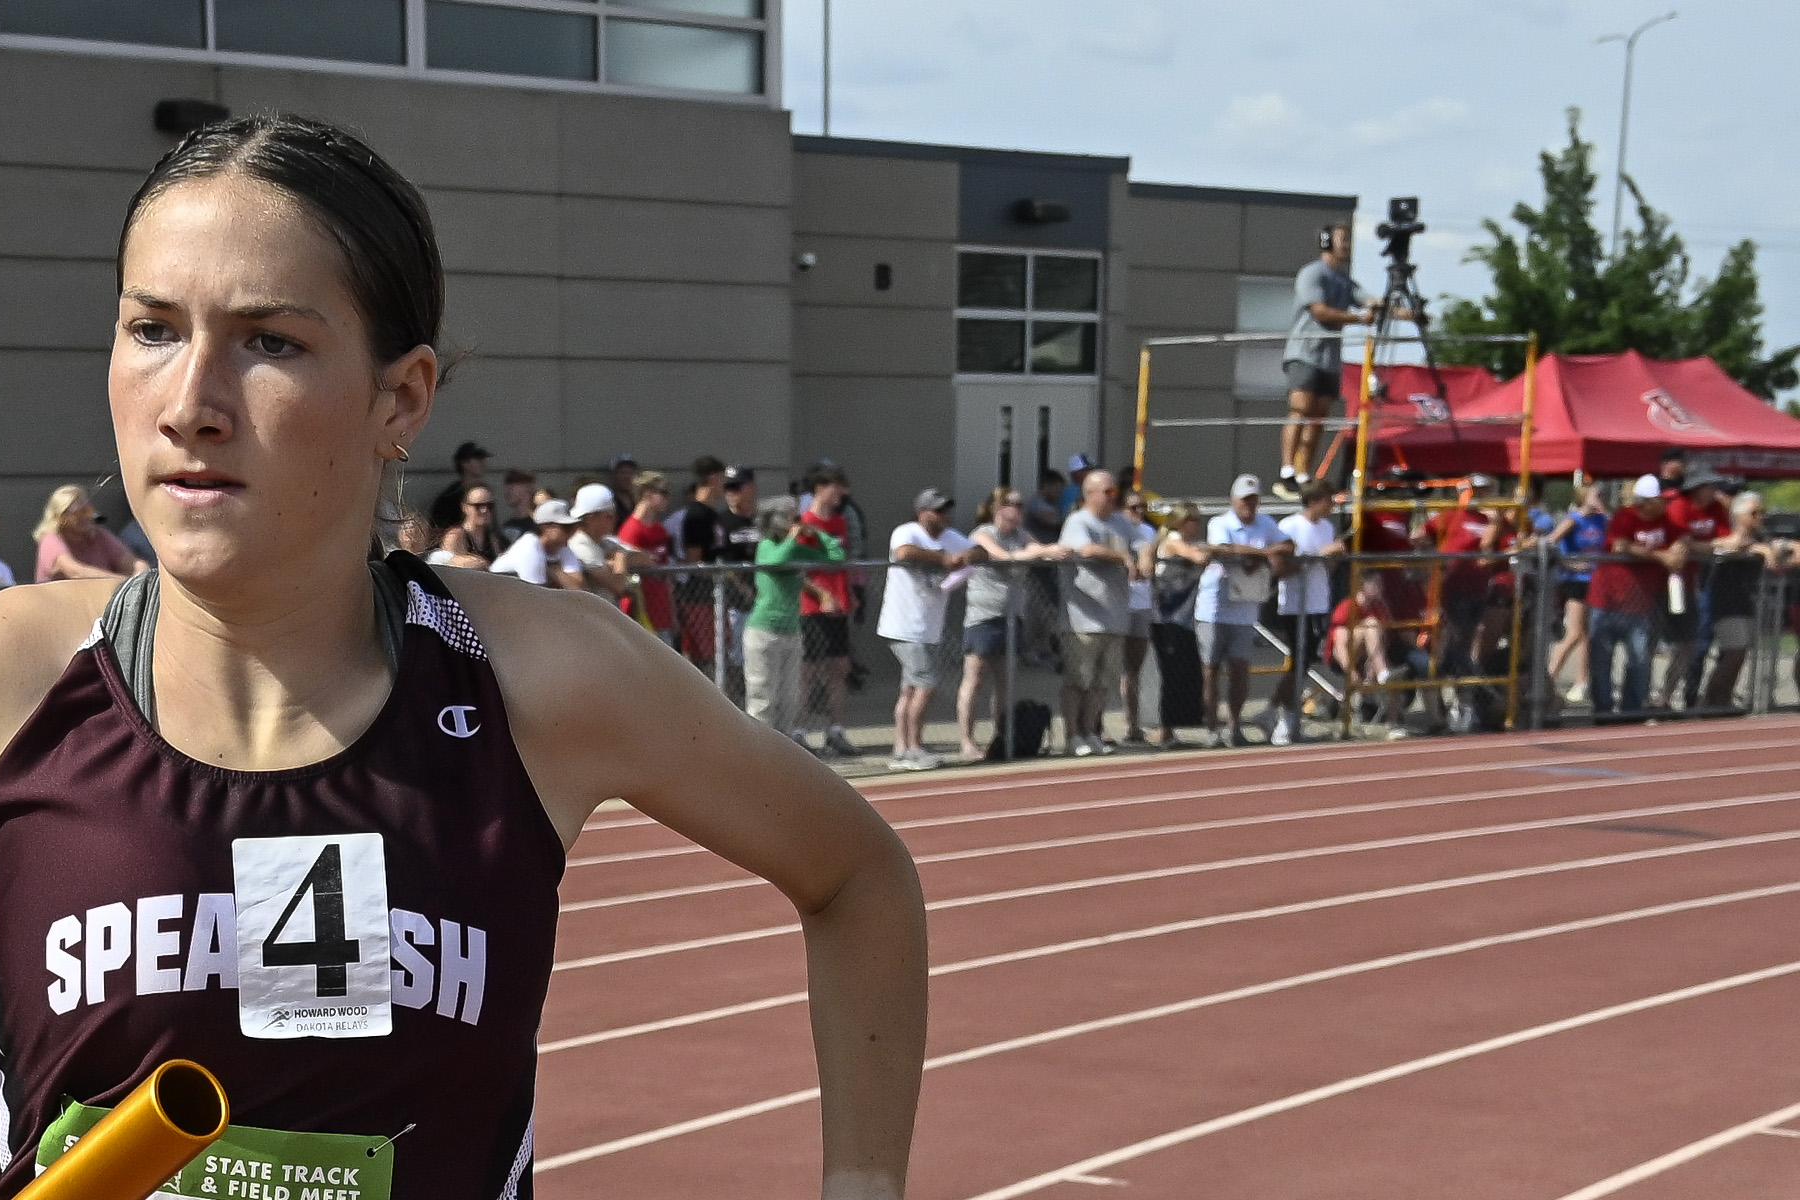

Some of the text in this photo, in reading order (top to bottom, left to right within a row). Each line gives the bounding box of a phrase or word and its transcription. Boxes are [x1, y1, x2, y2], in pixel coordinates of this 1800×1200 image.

[262, 844, 361, 998] 4
[294, 1006, 368, 1019] HOWARD WOOD
[296, 1020, 368, 1032] DAKOTA RELAYS
[205, 1155, 360, 1186] STATE TRACK
[201, 1176, 218, 1194] &
